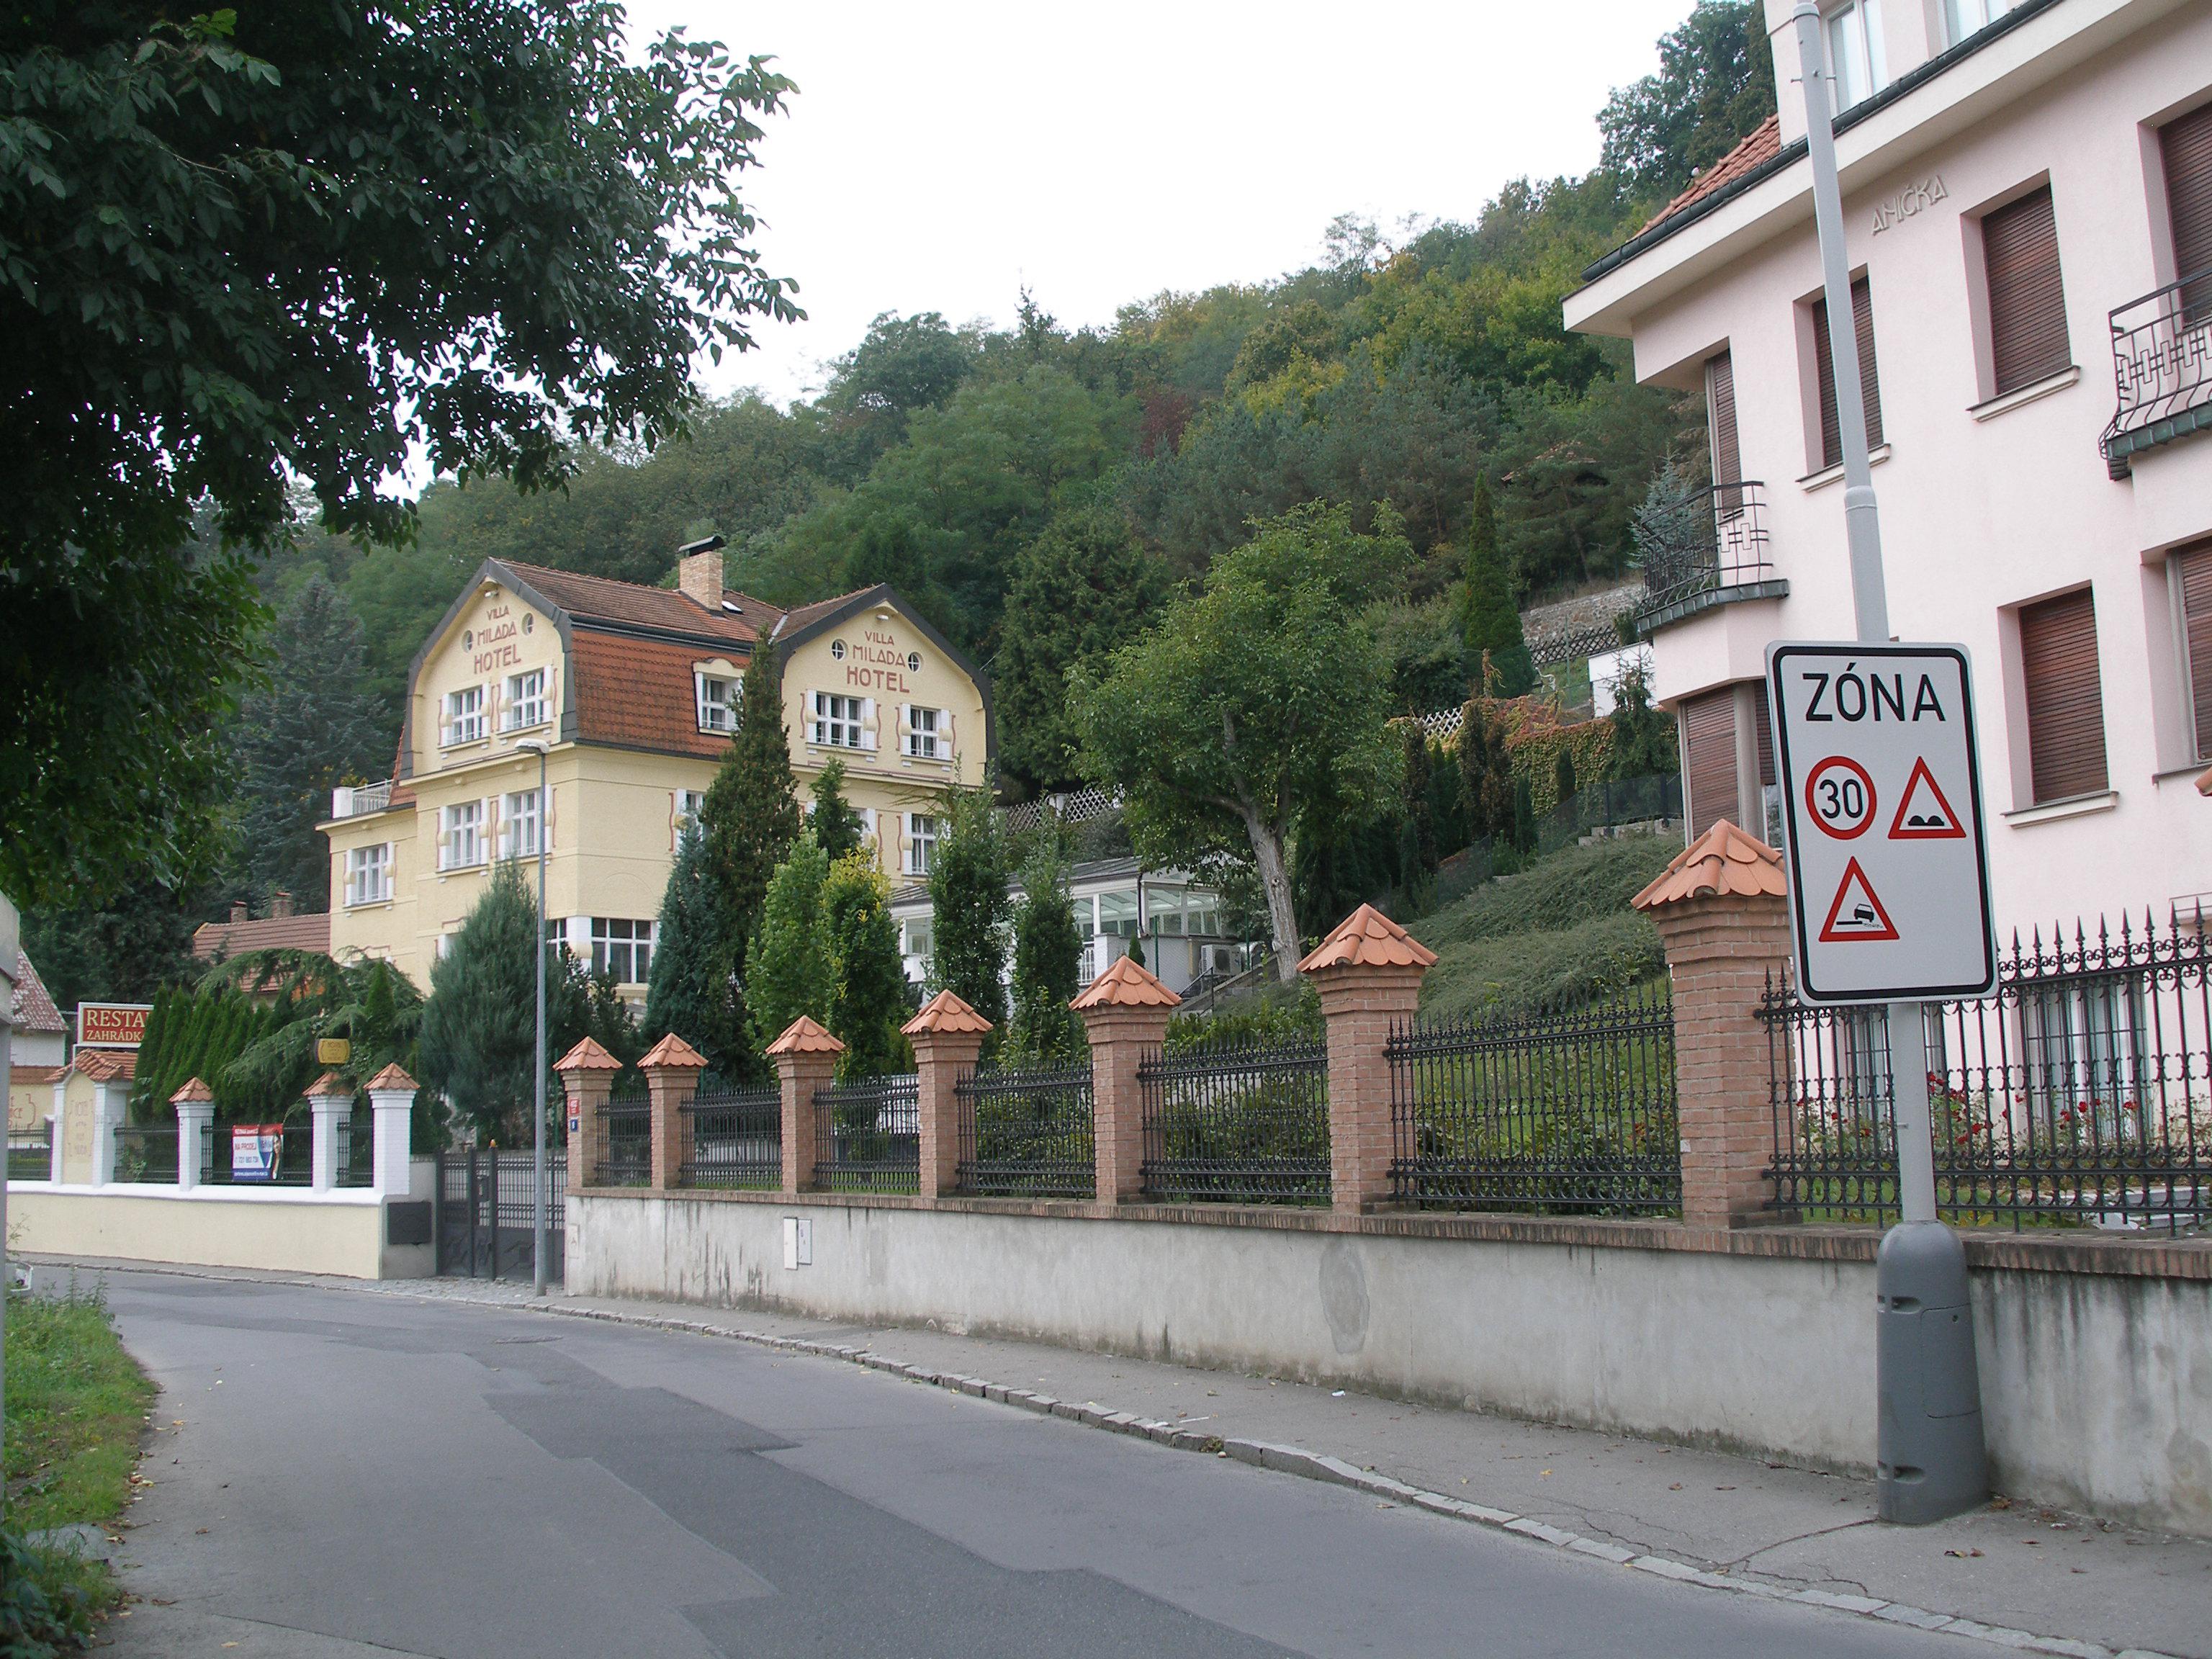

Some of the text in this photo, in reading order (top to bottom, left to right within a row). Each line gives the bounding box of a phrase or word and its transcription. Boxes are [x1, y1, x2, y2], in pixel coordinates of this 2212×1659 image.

[486, 605, 510, 621] VILLA
[477, 621, 517, 646] MILADA
[864, 630, 895, 646] VILLA
[473, 643, 521, 675] HOTEL
[852, 644, 906, 667] MILADA
[846, 665, 910, 693] HOTEL
[1802, 662, 1946, 721] ZÓNA
[1819, 778, 1863, 819] 30
